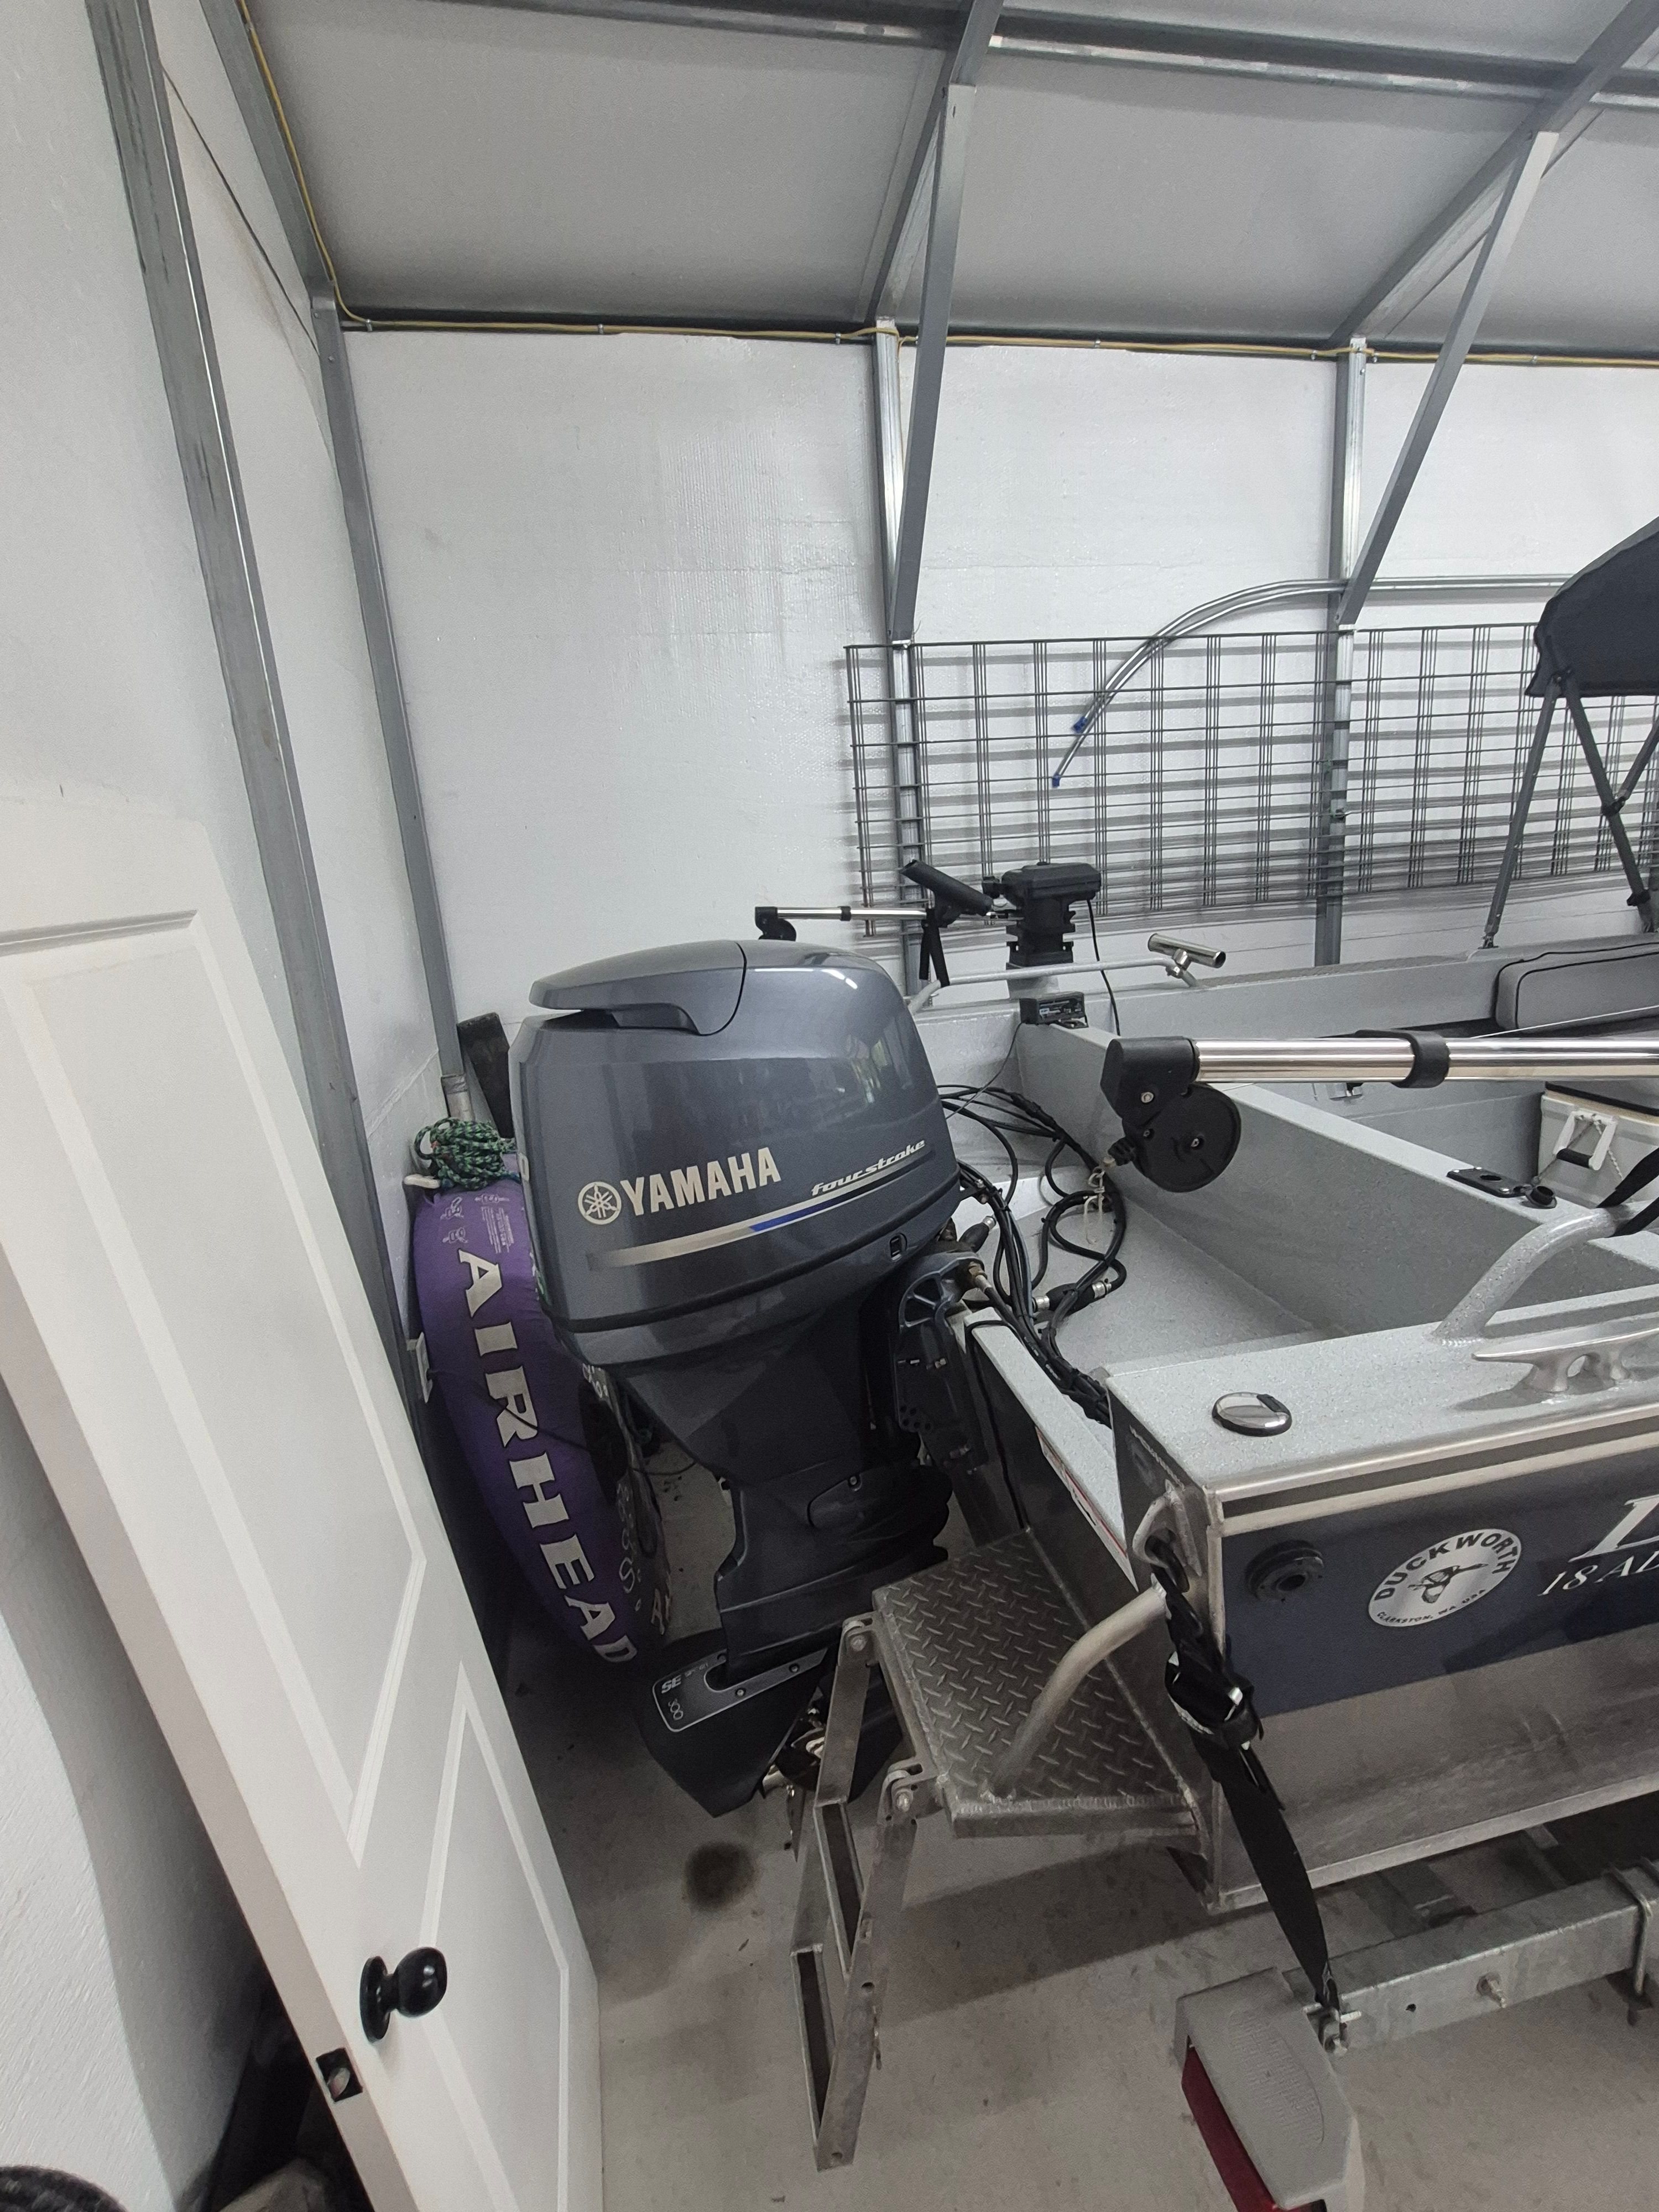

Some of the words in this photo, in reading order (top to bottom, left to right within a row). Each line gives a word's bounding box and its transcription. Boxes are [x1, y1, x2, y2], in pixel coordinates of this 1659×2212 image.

[620, 1147, 781, 1216] YAMAHA
[458, 1248, 638, 1663] AIRHEAD
[1374, 1532, 1518, 1601] DUCKWORTH
[1537, 1564, 1598, 1597] 18
[661, 1674, 682, 1694] SE
